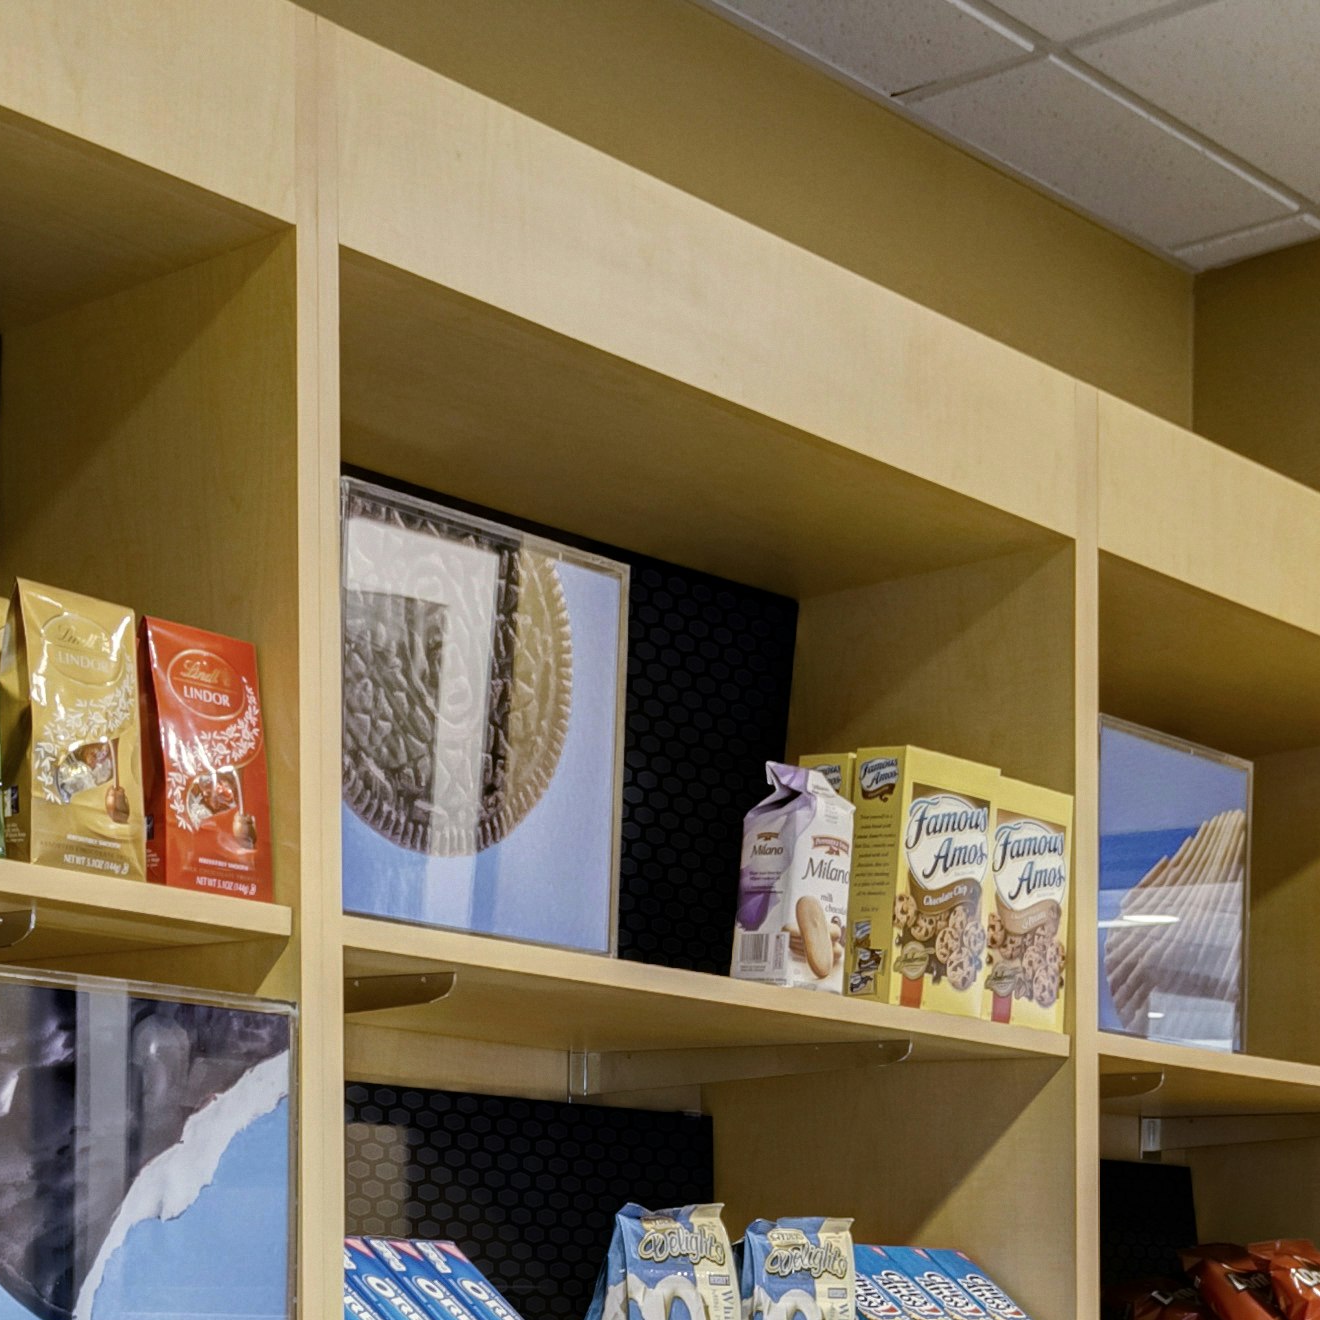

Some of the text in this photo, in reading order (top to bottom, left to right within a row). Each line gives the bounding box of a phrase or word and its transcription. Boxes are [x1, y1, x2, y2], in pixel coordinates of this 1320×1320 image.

[57, 651, 110, 674] LINDOR
[183, 685, 231, 708] LINDOR
[905, 798, 989, 850] Famous
[751, 843, 784, 858] Milano
[922, 837, 988, 879] Amos
[992, 825, 1065, 873] Famous
[1007, 860, 1066, 901] Amos
[637, 1227, 726, 1266] Delights
[765, 1242, 848, 1280] Delights
